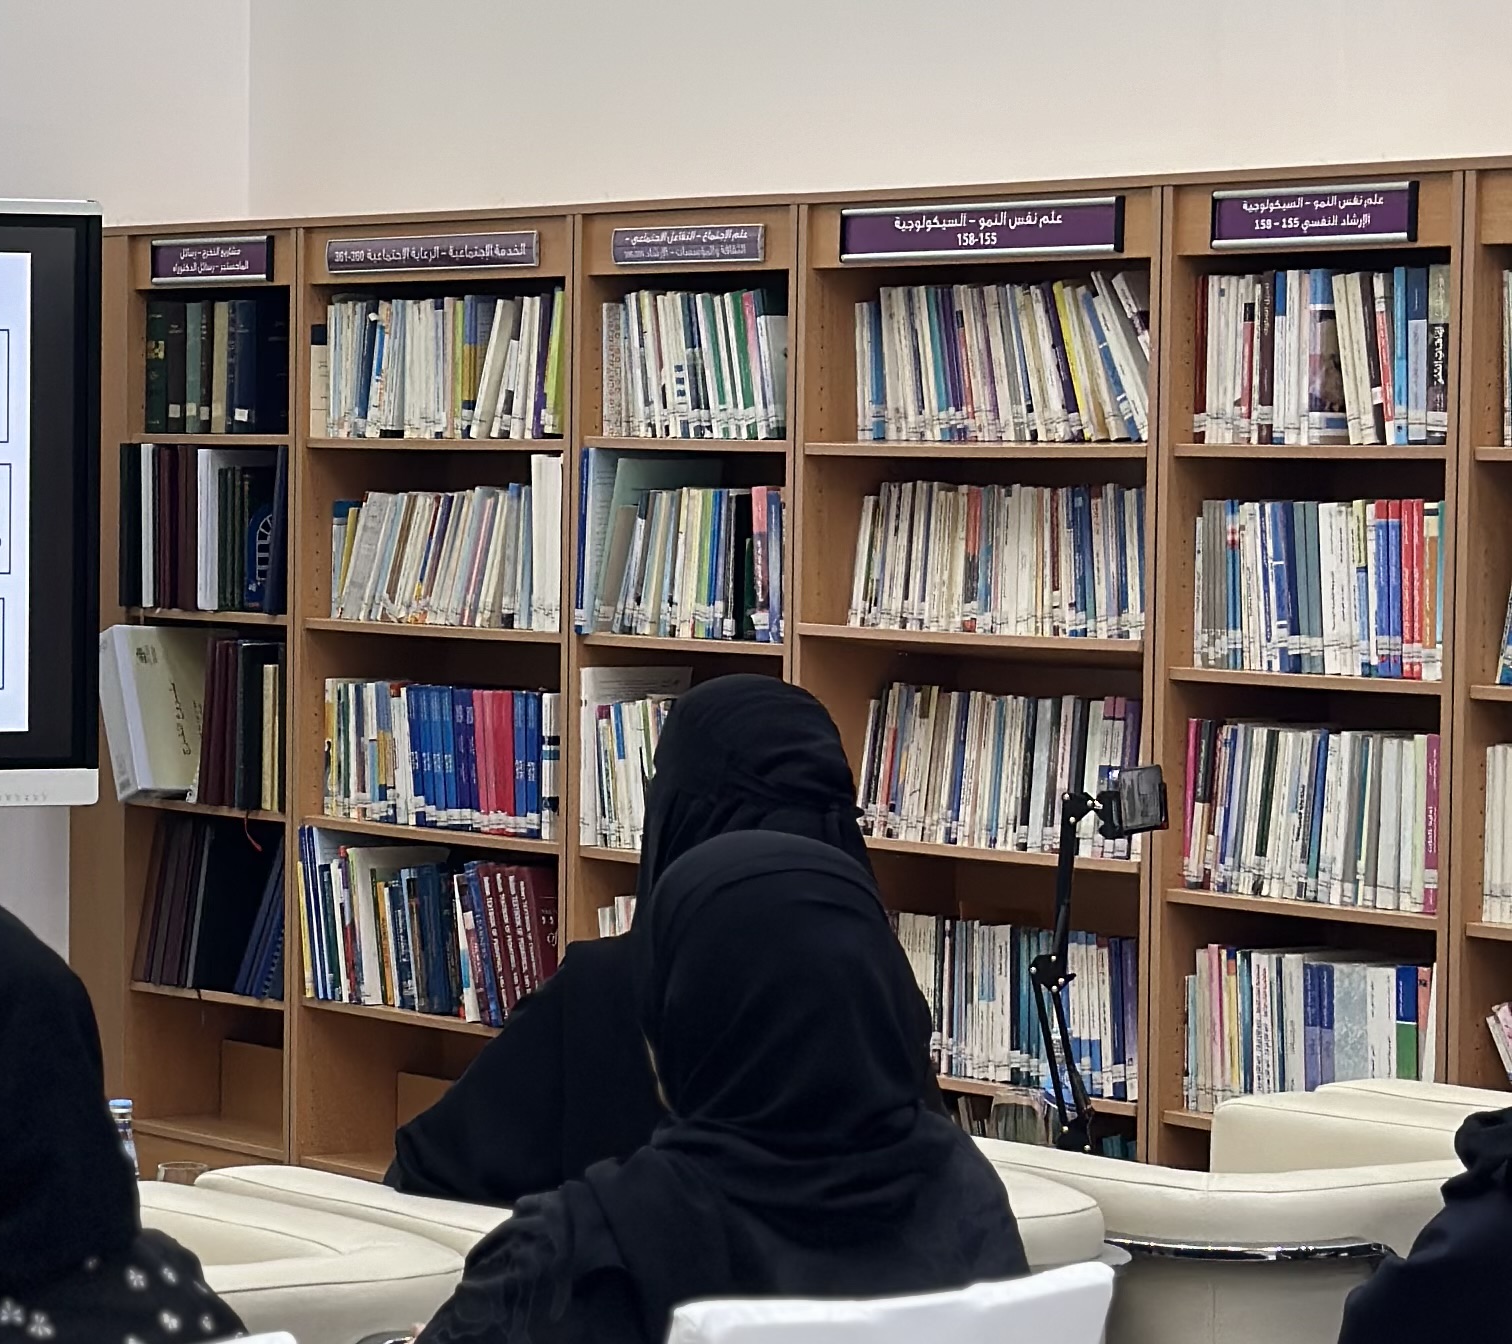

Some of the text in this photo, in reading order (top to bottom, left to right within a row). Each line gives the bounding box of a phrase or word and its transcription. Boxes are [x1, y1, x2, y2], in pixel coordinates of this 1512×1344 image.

[1243, 194, 1383, 213] علم نفس النمو السيكولوجية
[895, 210, 1062, 232] علم نفس النمو السيكولوجية
[1282, 217, 1299, 228] 155
[1302, 215, 1337, 232] النفسي
[1340, 213, 1370, 228] الإرشاد
[732, 230, 747, 240] علم
[957, 232, 997, 245] 158-155
[180, 248, 197, 259] رسائل
[221, 247, 240, 257] مشاريع
[411, 247, 439, 262] الرعاية
[495, 243, 526, 256] الخدمة
